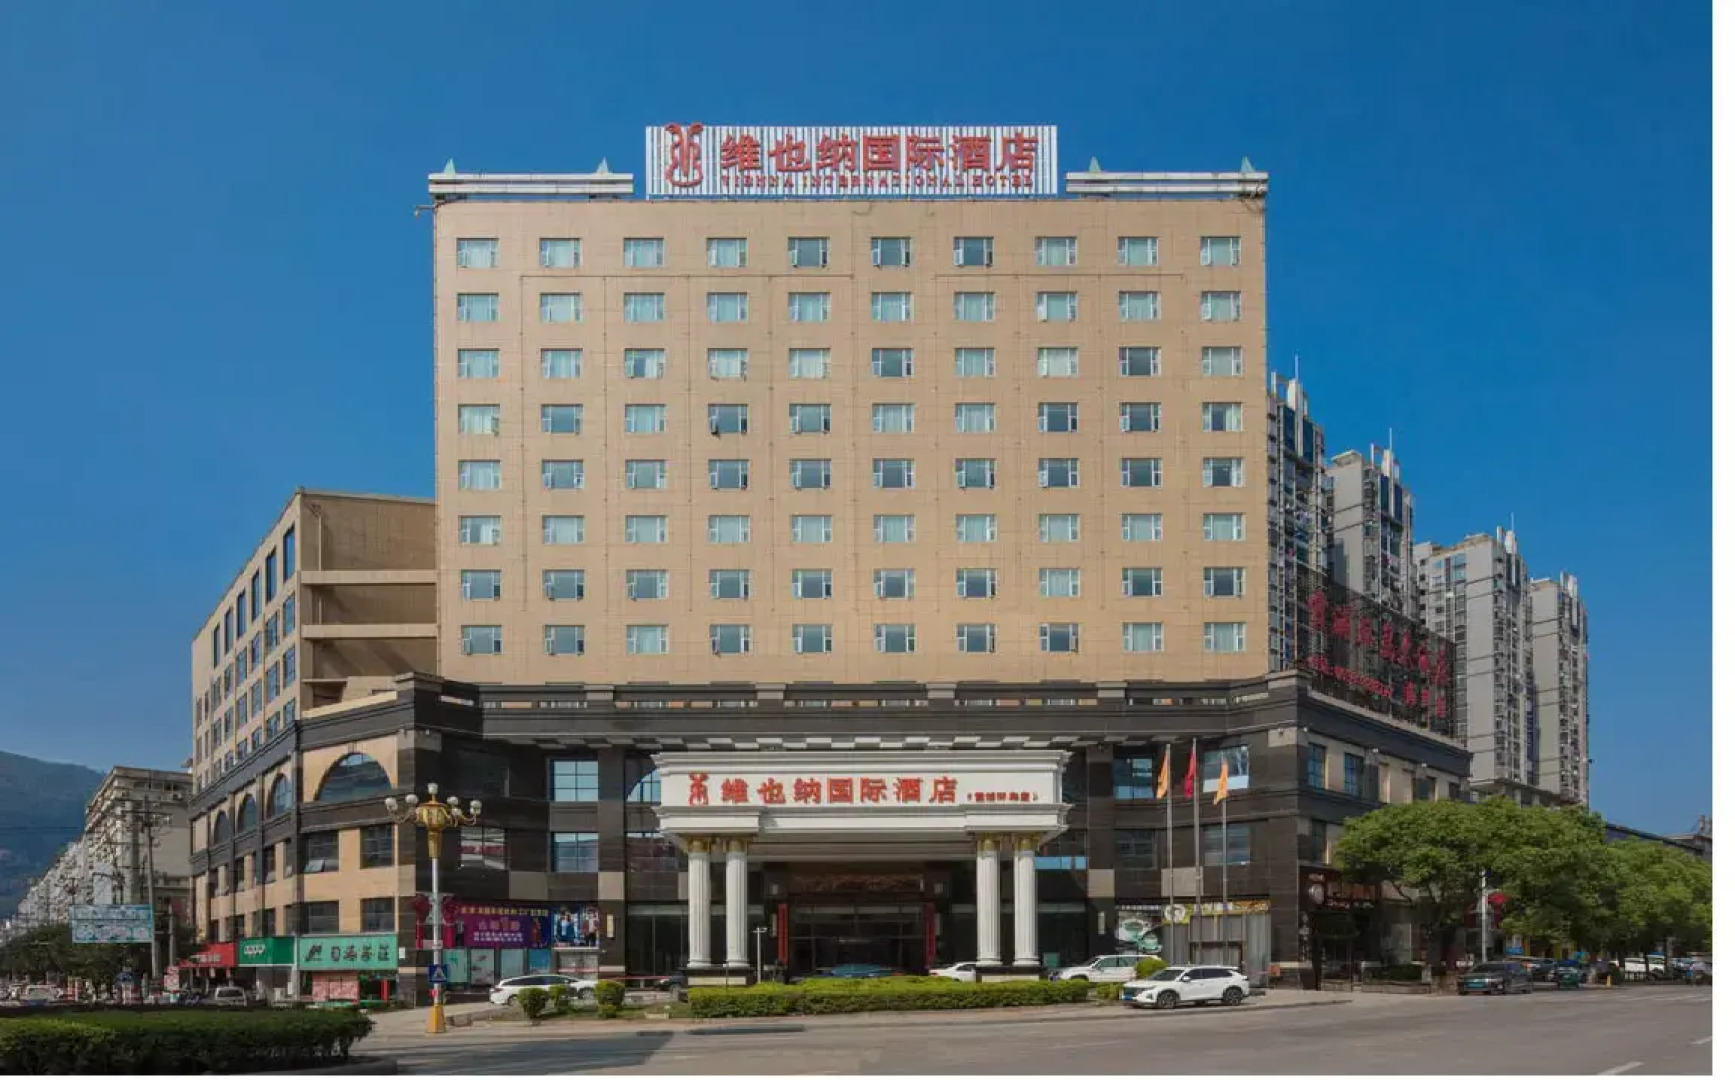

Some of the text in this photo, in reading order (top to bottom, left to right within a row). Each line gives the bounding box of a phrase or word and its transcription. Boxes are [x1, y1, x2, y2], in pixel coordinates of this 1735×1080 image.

[720, 133, 1039, 172] 维也纳国际酒店
[720, 776, 958, 805] 维也纳国际酒店
